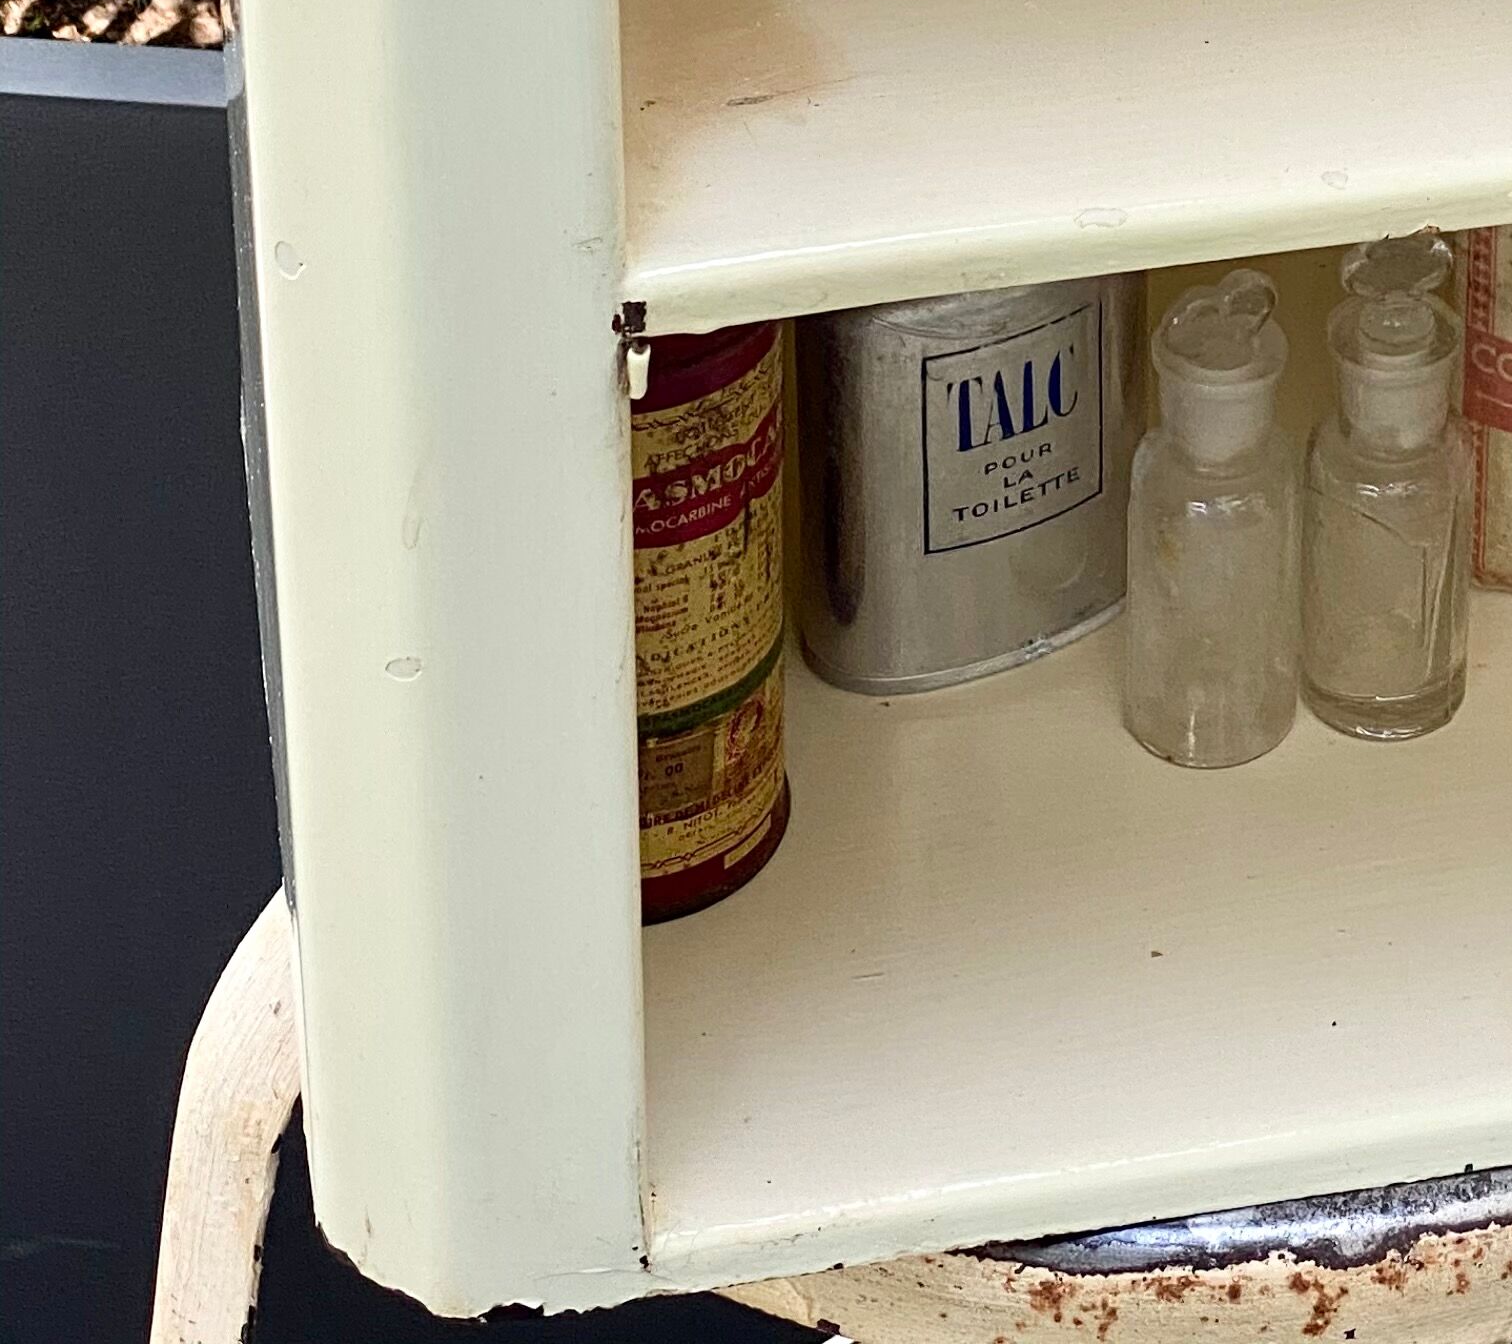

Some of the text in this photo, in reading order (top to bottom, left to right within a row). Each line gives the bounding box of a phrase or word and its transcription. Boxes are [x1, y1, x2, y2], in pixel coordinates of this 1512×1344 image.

[945, 341, 1079, 453] TALC
[983, 442, 1054, 476] POUR
[1002, 468, 1034, 490] LA
[951, 466, 1081, 523] TOILETTE
